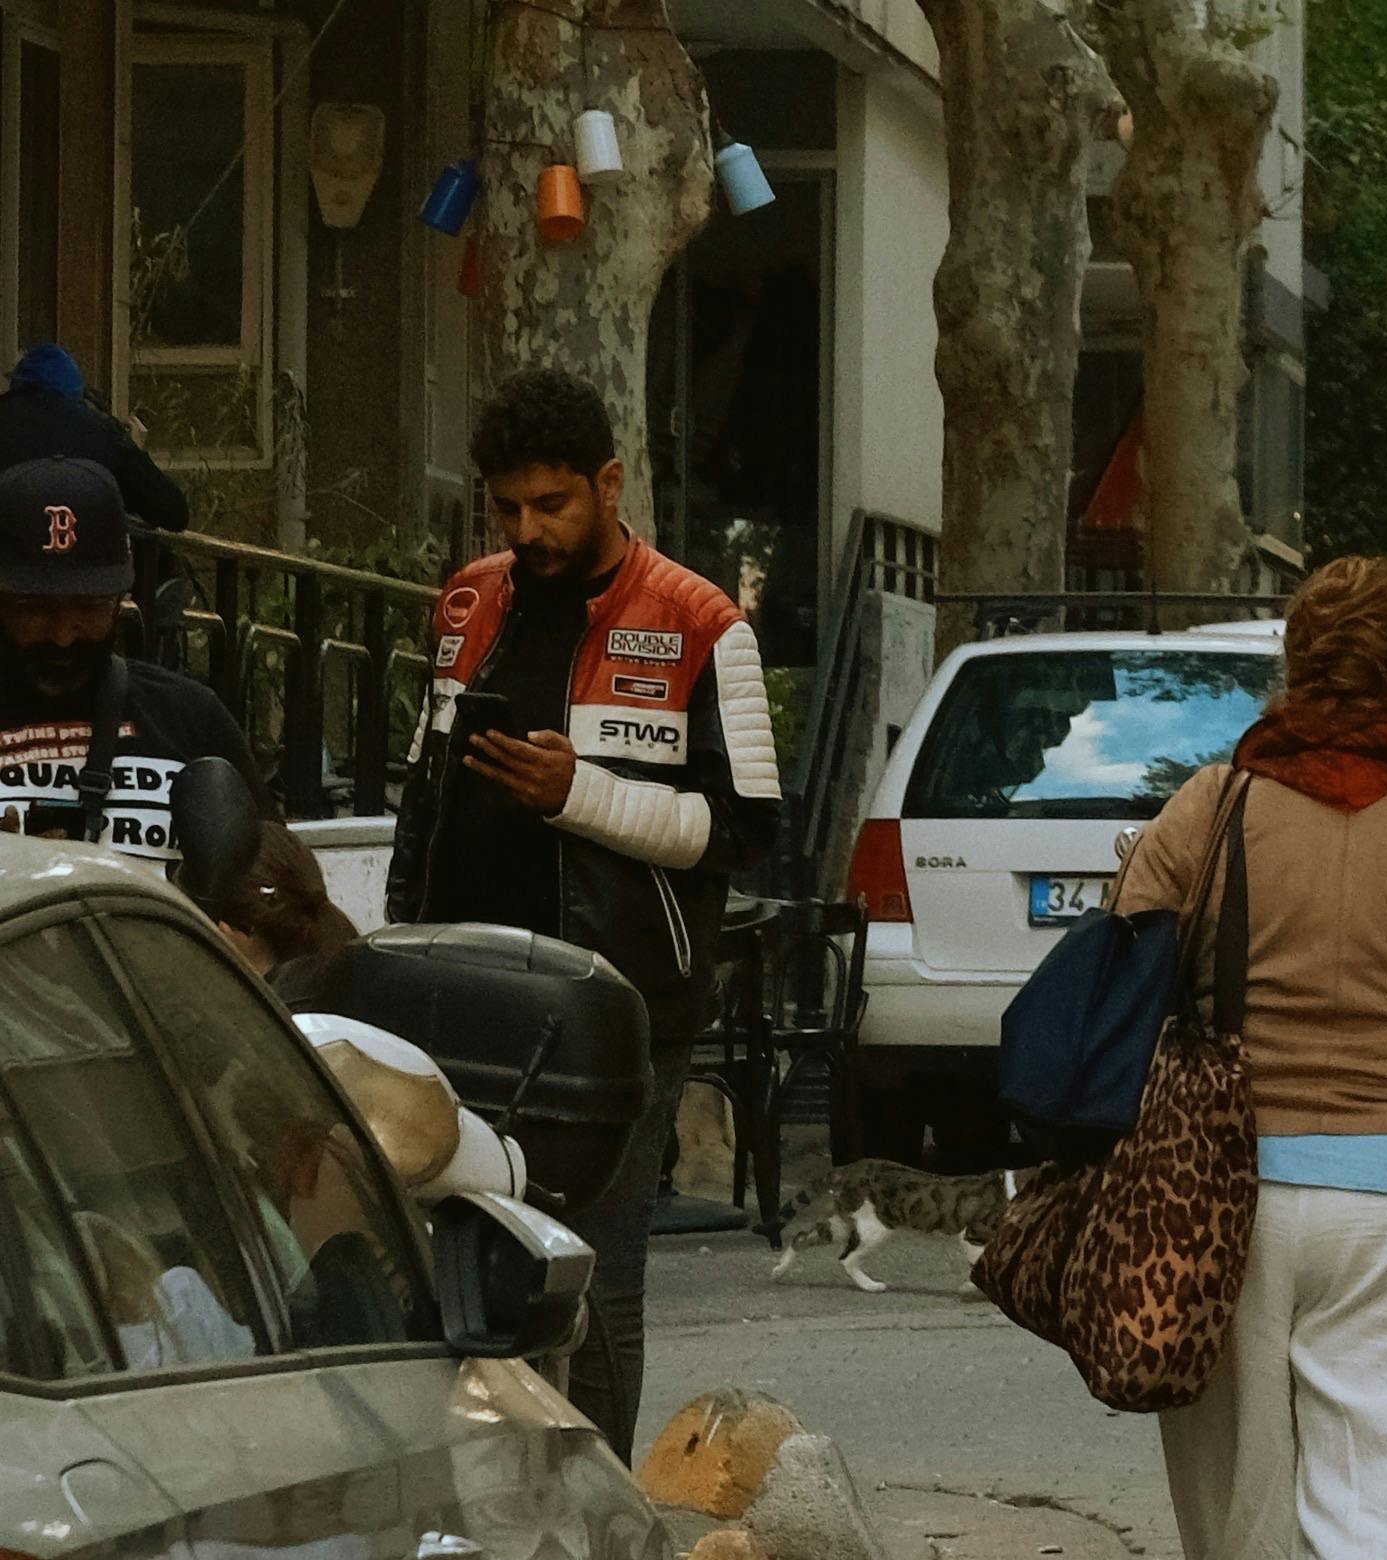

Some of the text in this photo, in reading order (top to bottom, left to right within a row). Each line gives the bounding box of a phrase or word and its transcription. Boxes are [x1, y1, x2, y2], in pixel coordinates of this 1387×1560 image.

[42, 505, 77, 553] B
[611, 640, 678, 655] DIVISION
[601, 720, 680, 744] STWD
[915, 857, 967, 868] BORA
[1048, 882, 1084, 912] 34
